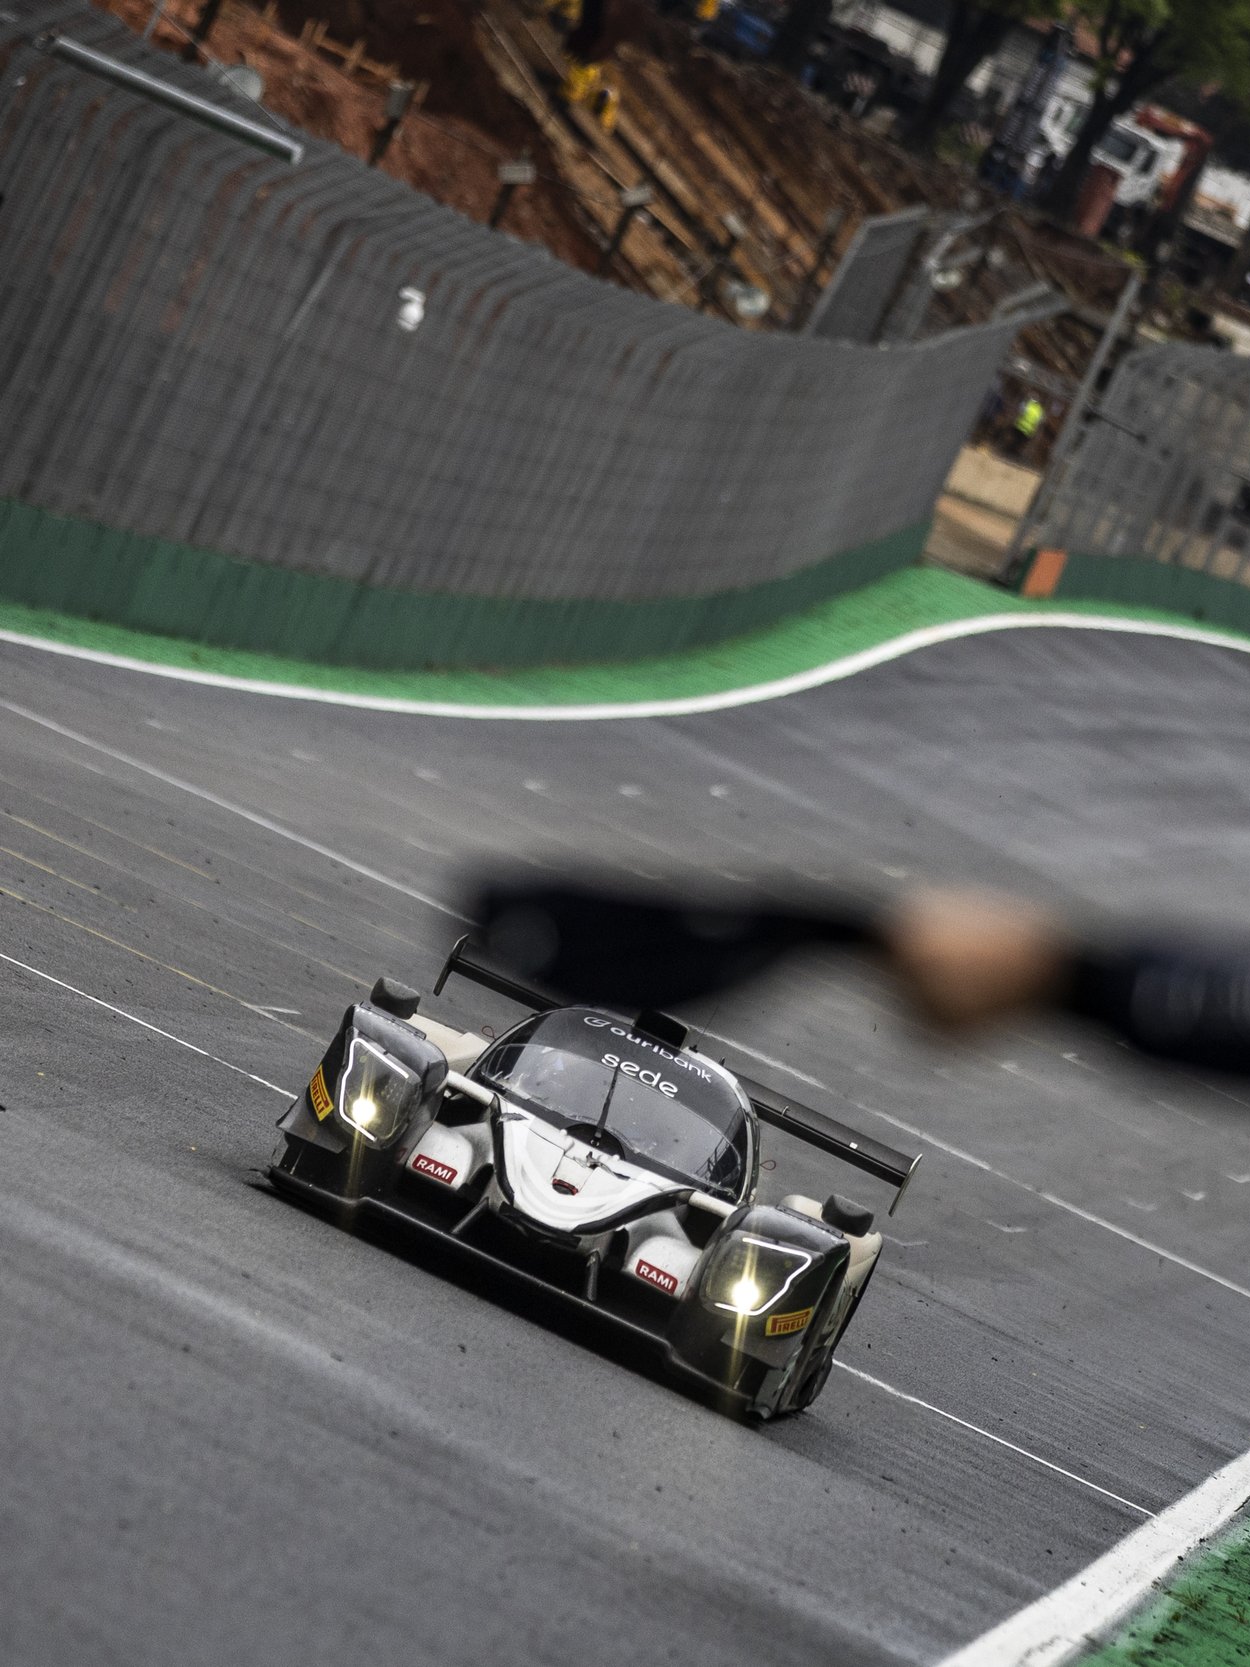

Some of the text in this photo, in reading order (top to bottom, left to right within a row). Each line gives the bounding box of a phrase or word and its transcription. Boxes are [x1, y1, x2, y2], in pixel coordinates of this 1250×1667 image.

[610, 1027, 711, 1083] ouribank
[310, 1069, 330, 1114] PIRELLI
[601, 1053, 678, 1098] sede
[416, 1158, 452, 1180] RAMI
[639, 1265, 674, 1290] RAMI
[771, 1310, 810, 1333] PIRELLI
